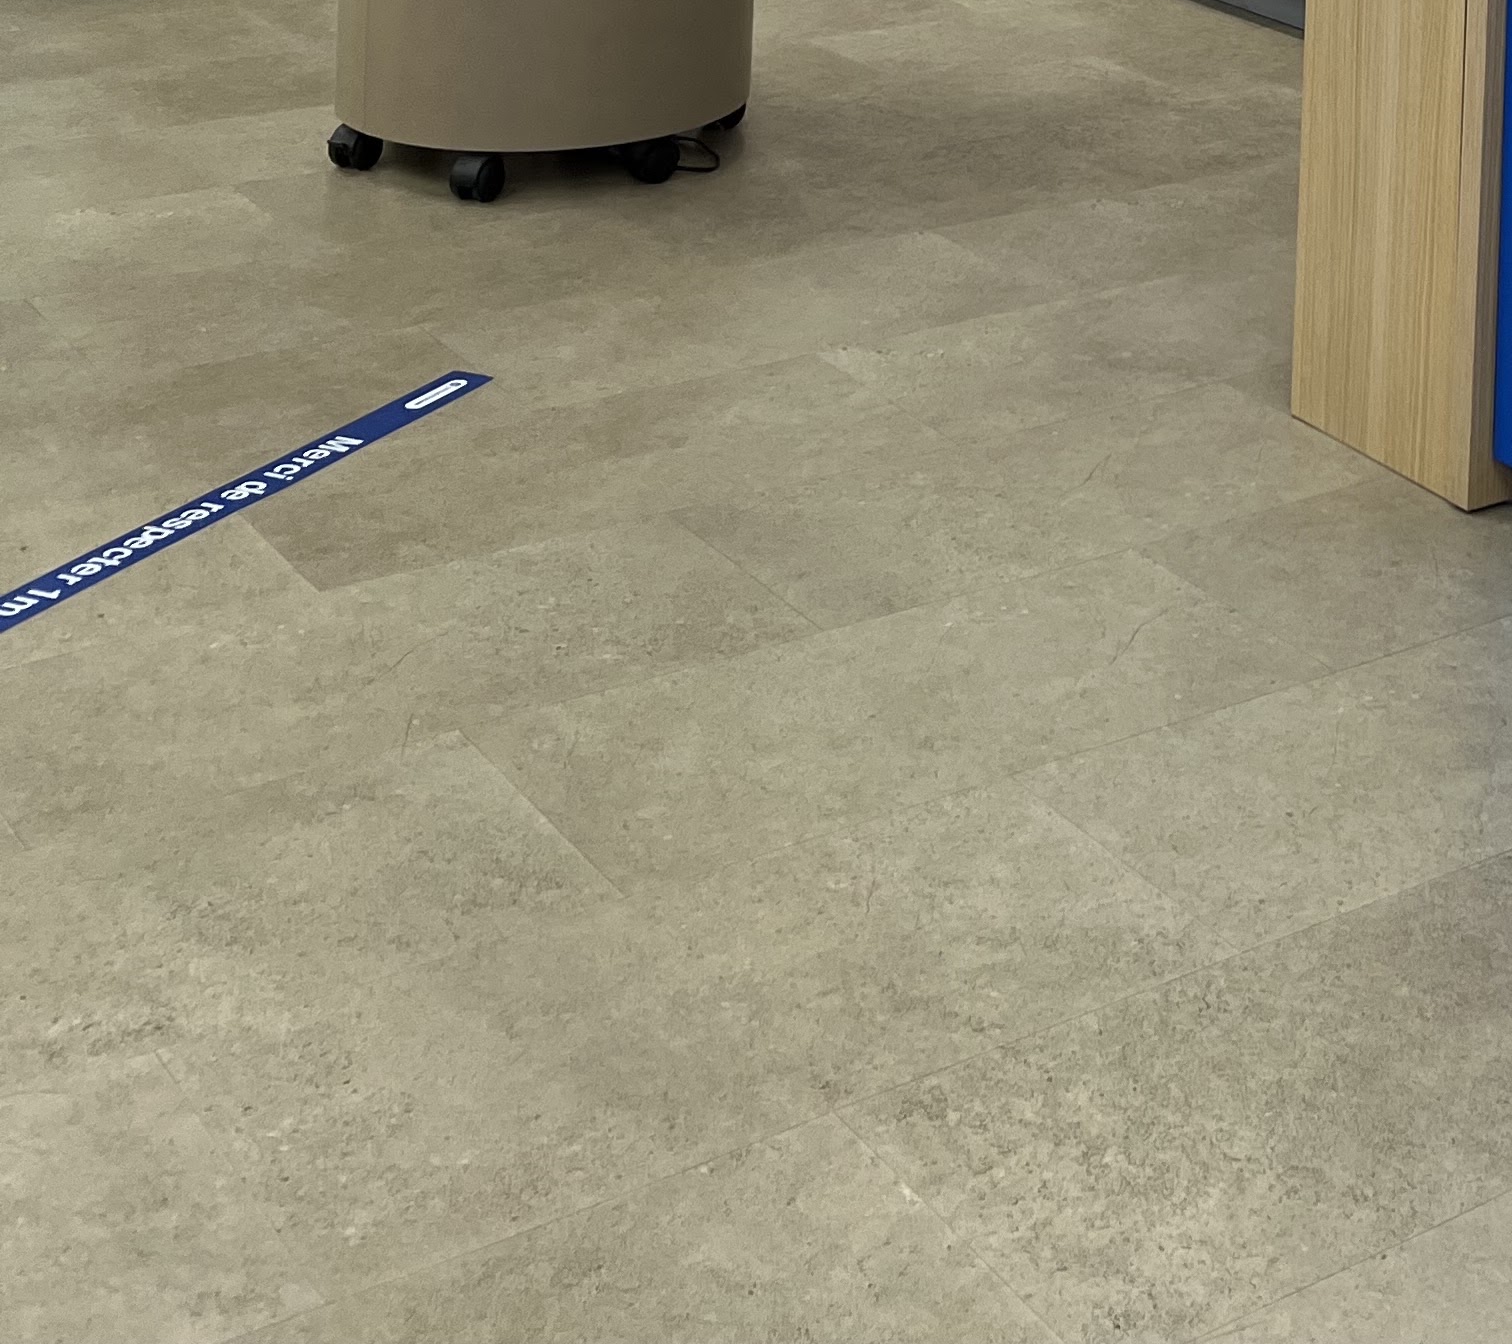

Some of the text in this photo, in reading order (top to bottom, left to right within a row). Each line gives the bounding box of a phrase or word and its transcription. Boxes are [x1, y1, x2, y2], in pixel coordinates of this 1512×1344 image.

[263, 435, 364, 481] Merci
[221, 480, 268, 502] de
[56, 501, 225, 585] respecter
